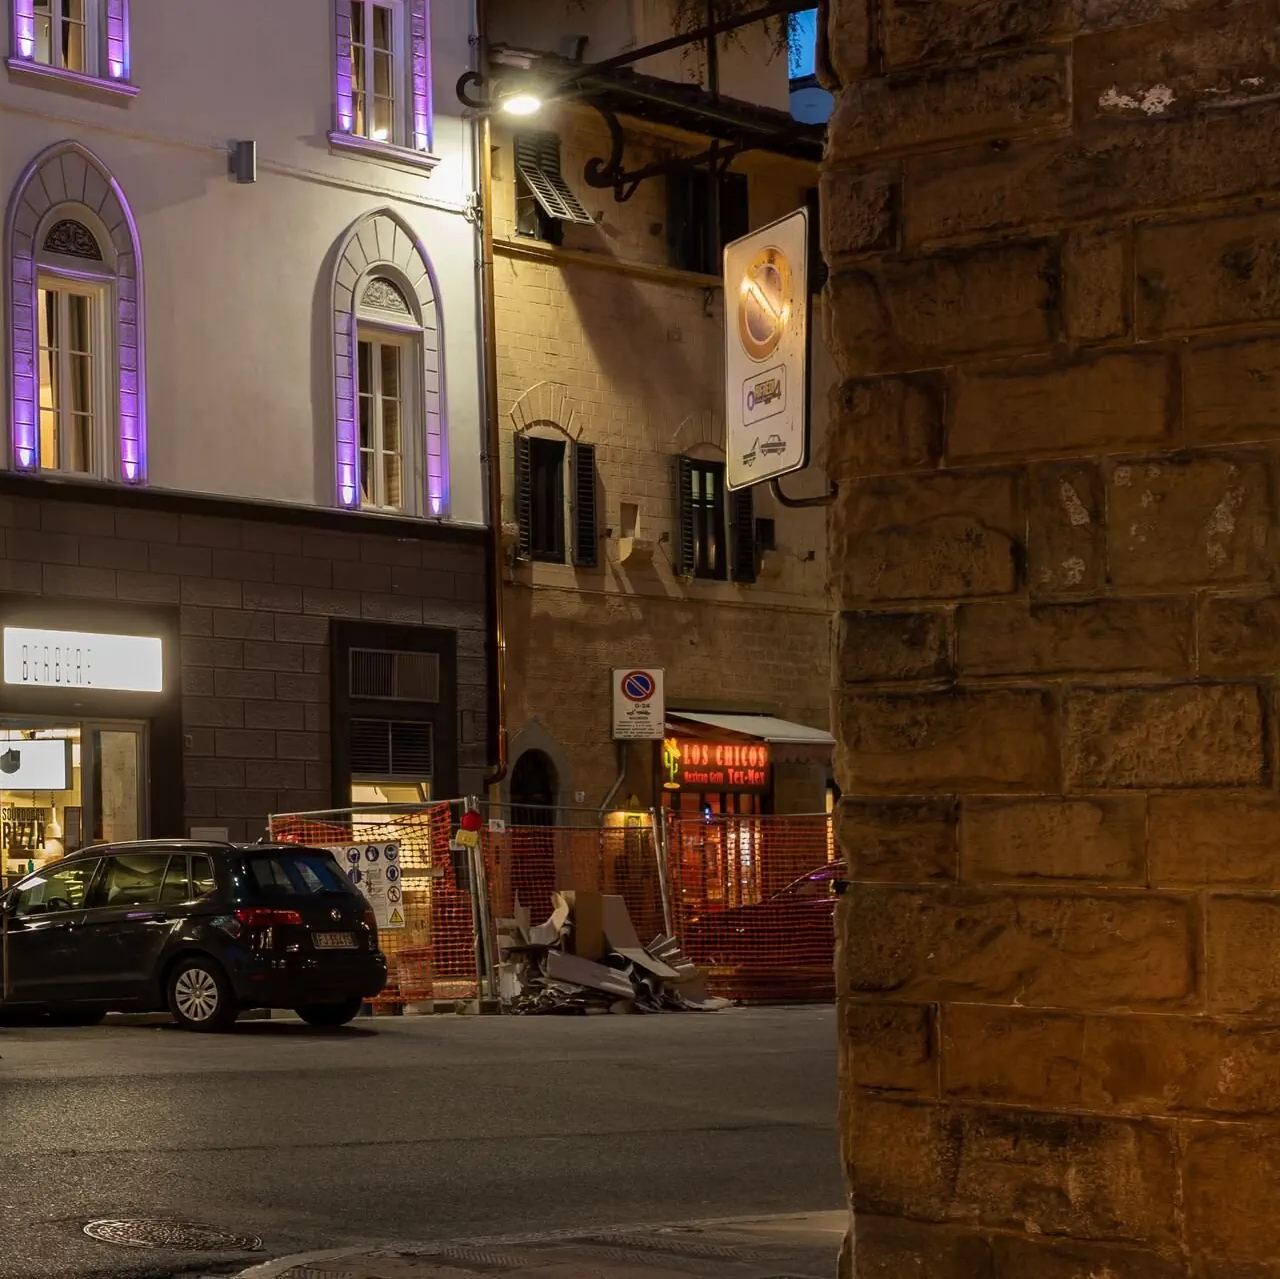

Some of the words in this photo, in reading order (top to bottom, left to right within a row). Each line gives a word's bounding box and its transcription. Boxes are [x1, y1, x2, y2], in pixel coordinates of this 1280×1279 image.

[684, 744, 708, 766] LOS
[715, 744, 766, 767] CHICOS
[727, 768, 765, 785] Tex-Mex
[2, 822, 45, 850] PIZZA
